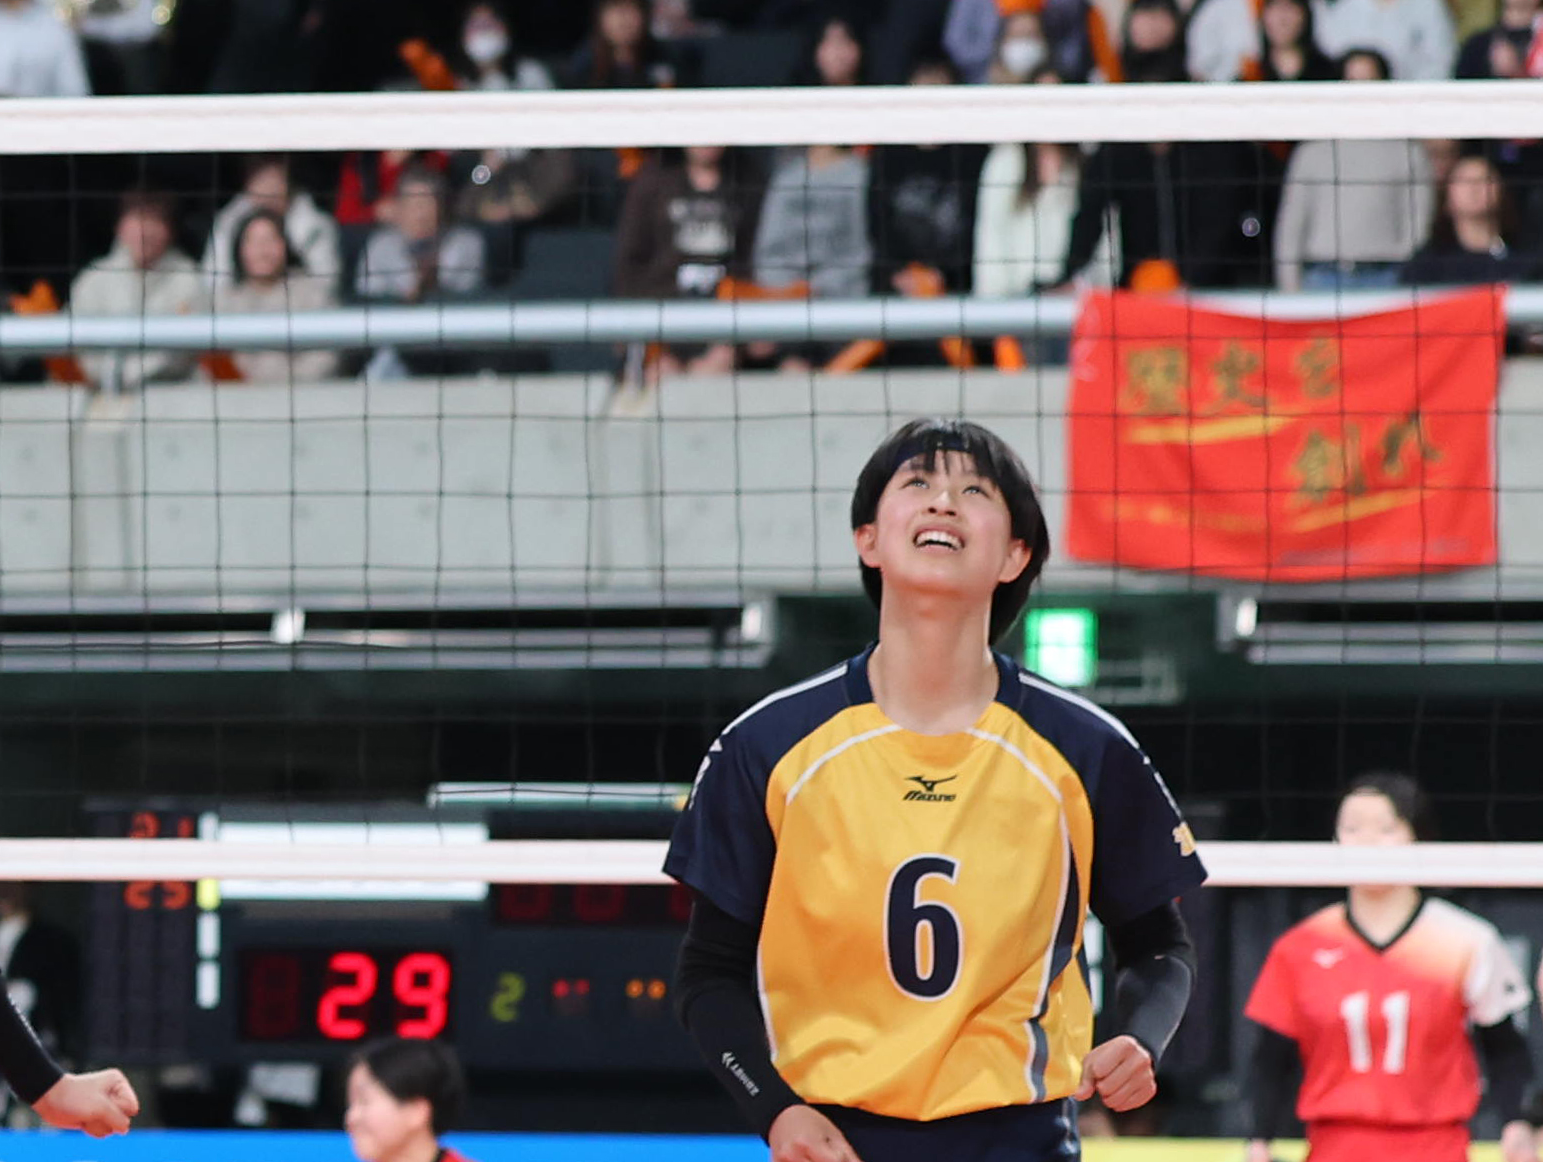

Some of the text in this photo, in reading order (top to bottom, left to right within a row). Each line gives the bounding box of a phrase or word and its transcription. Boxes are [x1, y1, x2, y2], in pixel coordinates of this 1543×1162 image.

[883, 853, 964, 1002] 6
[317, 951, 452, 1041] 29
[489, 971, 526, 1023] 2
[1342, 990, 1411, 1073] 11
